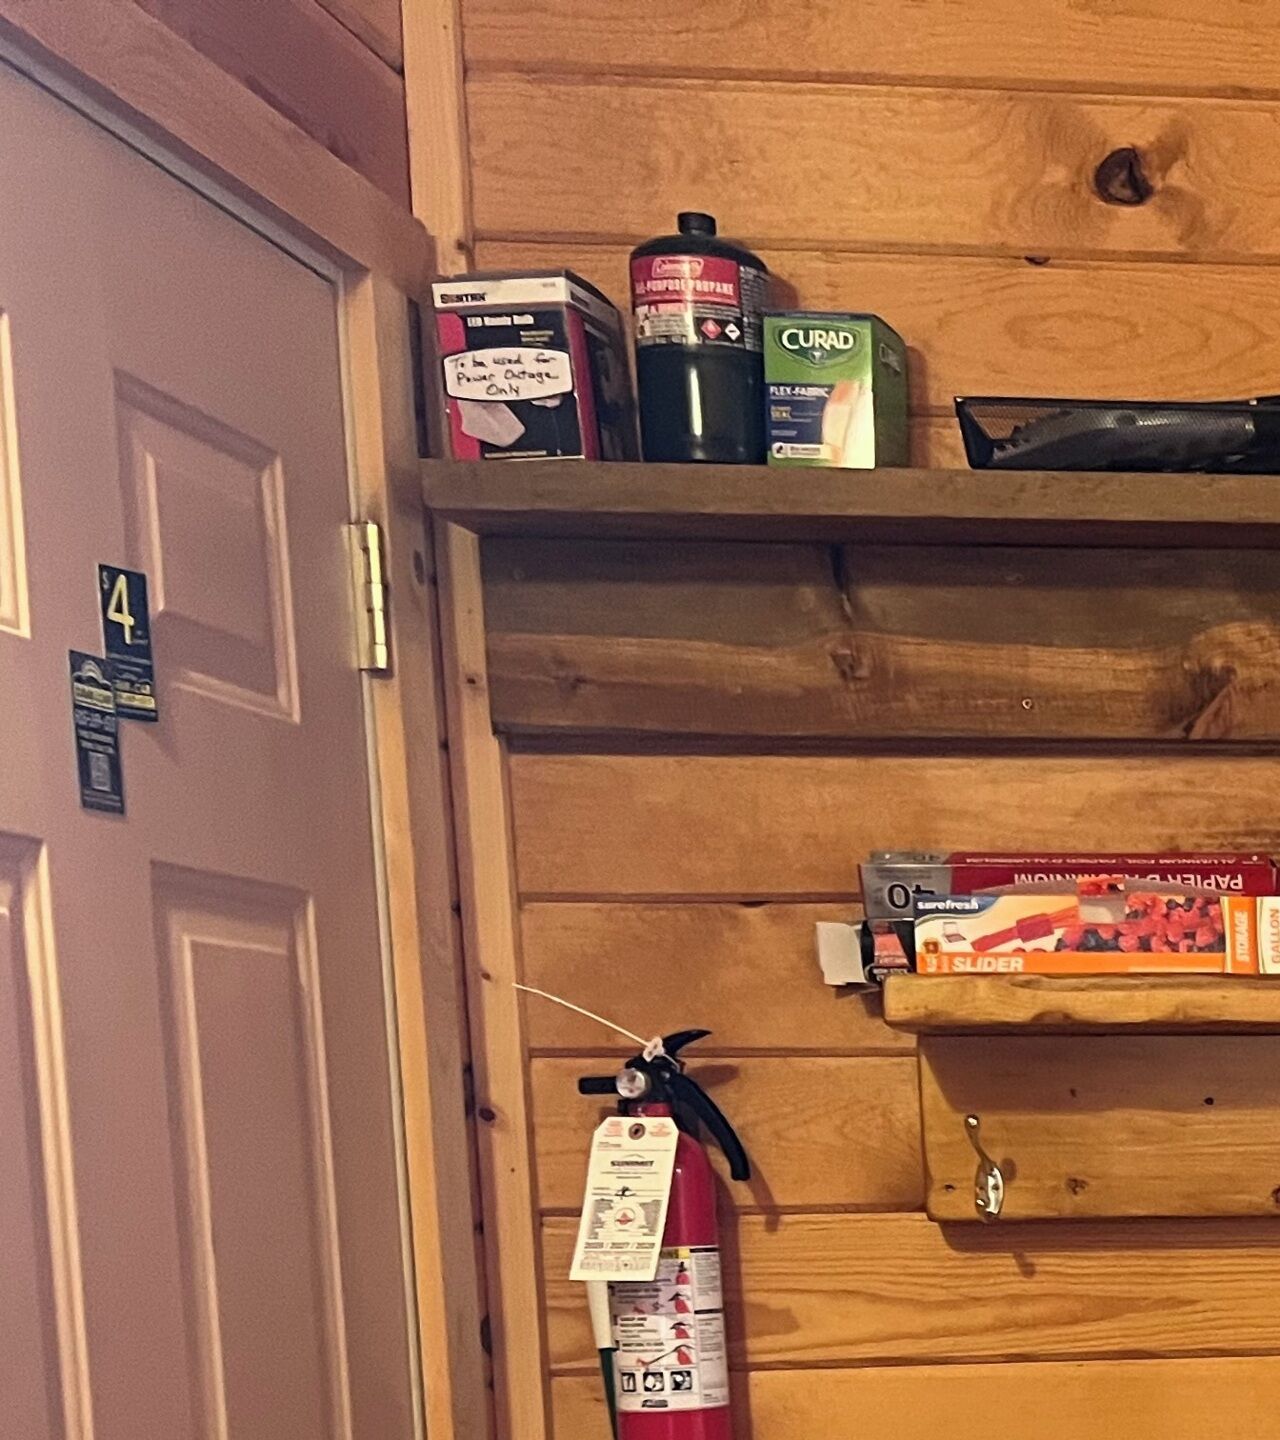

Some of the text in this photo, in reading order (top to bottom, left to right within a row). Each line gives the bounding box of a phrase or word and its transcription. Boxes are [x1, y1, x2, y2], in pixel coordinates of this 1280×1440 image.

[781, 328, 854, 351] CURAD
[449, 352, 556, 369] To be used for
[486, 383, 520, 396] Only
[107, 574, 135, 646] 4
[917, 897, 980, 911] surefresh
[952, 957, 1024, 972] SLIDER
